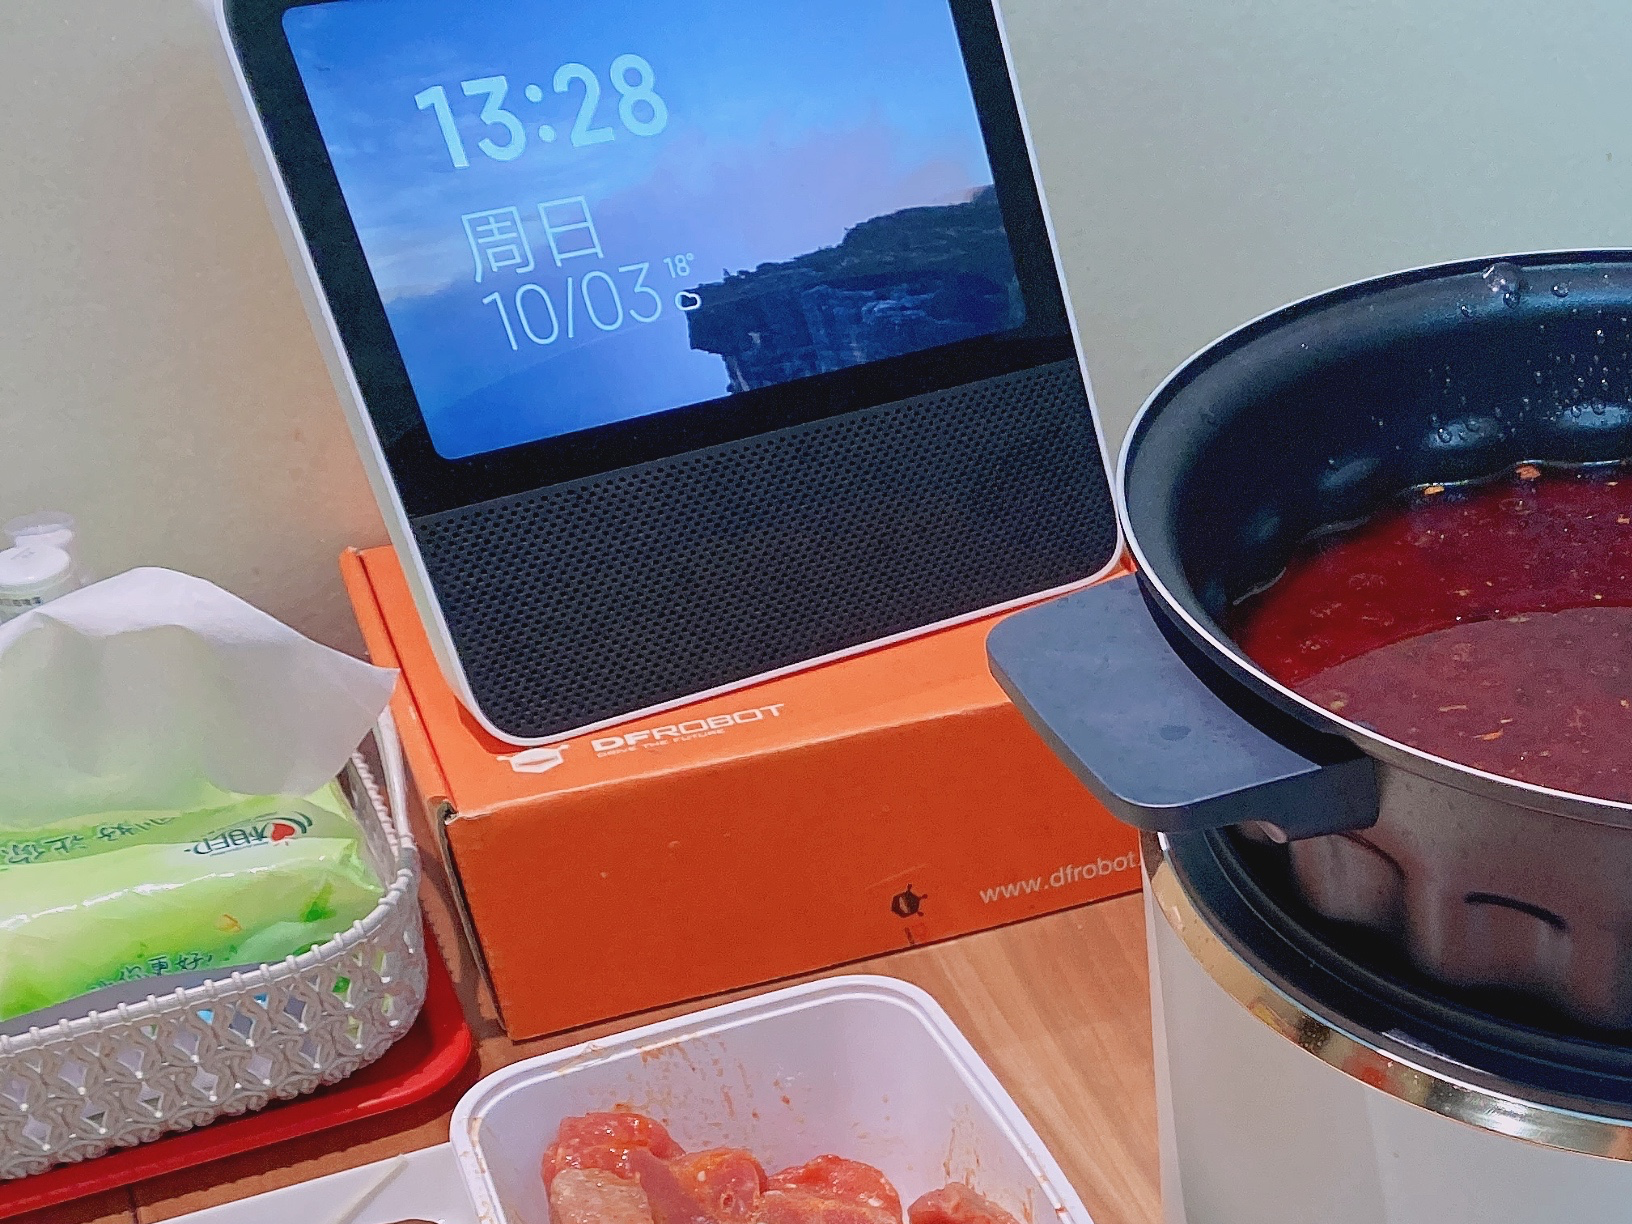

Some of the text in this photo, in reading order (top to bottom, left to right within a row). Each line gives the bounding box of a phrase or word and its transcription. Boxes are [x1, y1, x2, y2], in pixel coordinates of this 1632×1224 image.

[414, 53, 669, 168] 13:28
[461, 196, 604, 283] 周日
[482, 262, 663, 350] 10/03
[591, 703, 784, 752] DFROBOT
[643, 737, 669, 749] THE
[672, 728, 726, 743] FUTURE
